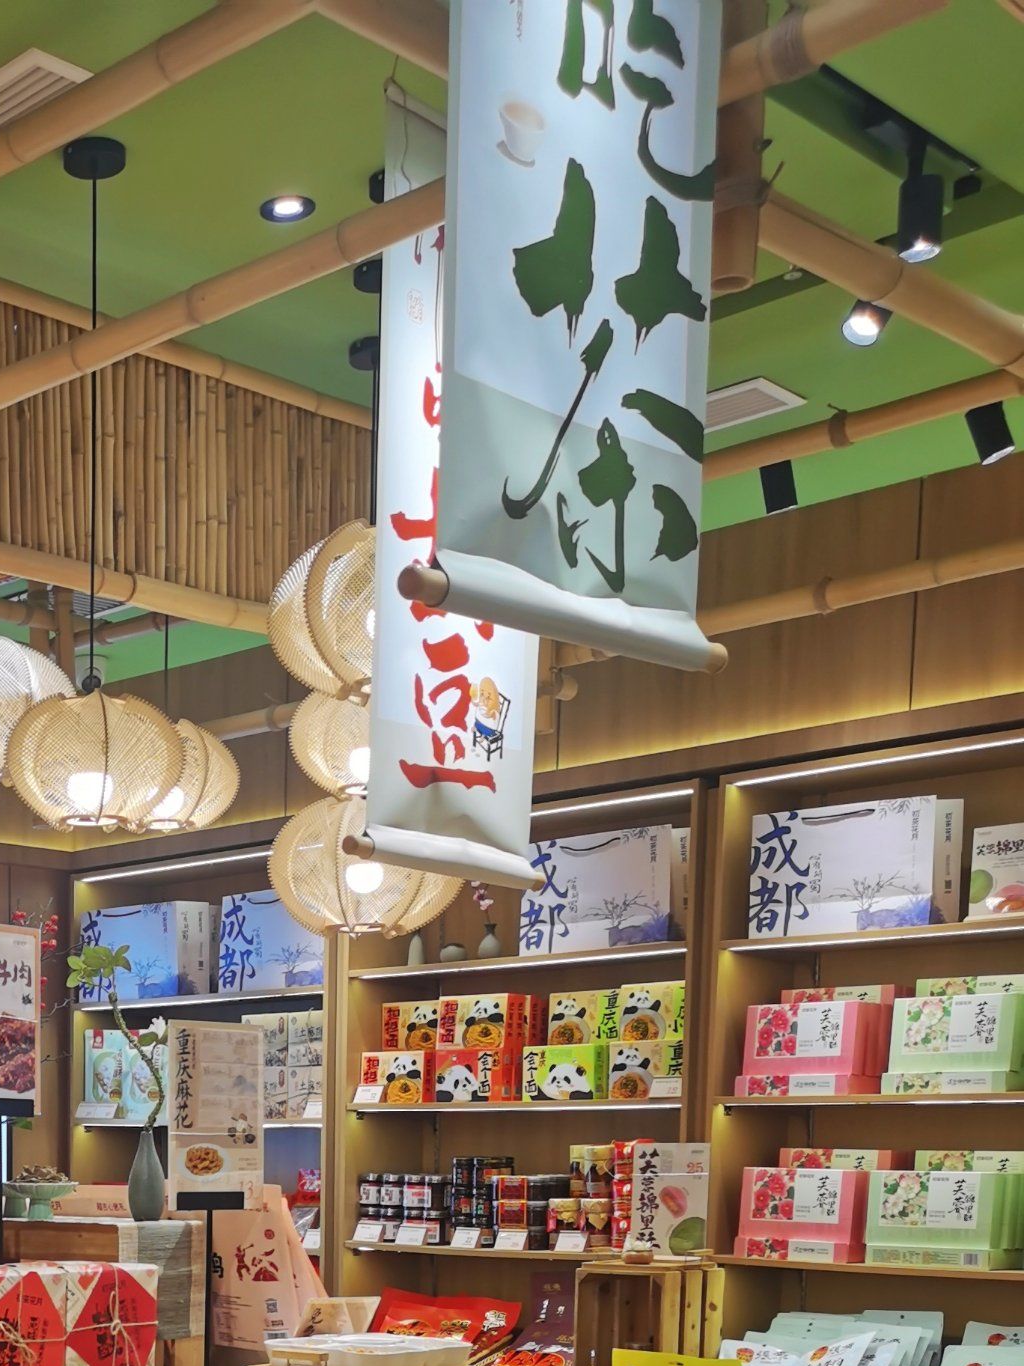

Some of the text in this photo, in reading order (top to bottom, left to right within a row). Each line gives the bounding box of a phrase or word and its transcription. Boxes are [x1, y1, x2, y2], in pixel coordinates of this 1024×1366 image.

[748, 811, 810, 936] 成都
[218, 894, 256, 992] 成都
[440, 1000, 458, 1044] 担担面
[174, 1029, 193, 1129] 重庆麻花
